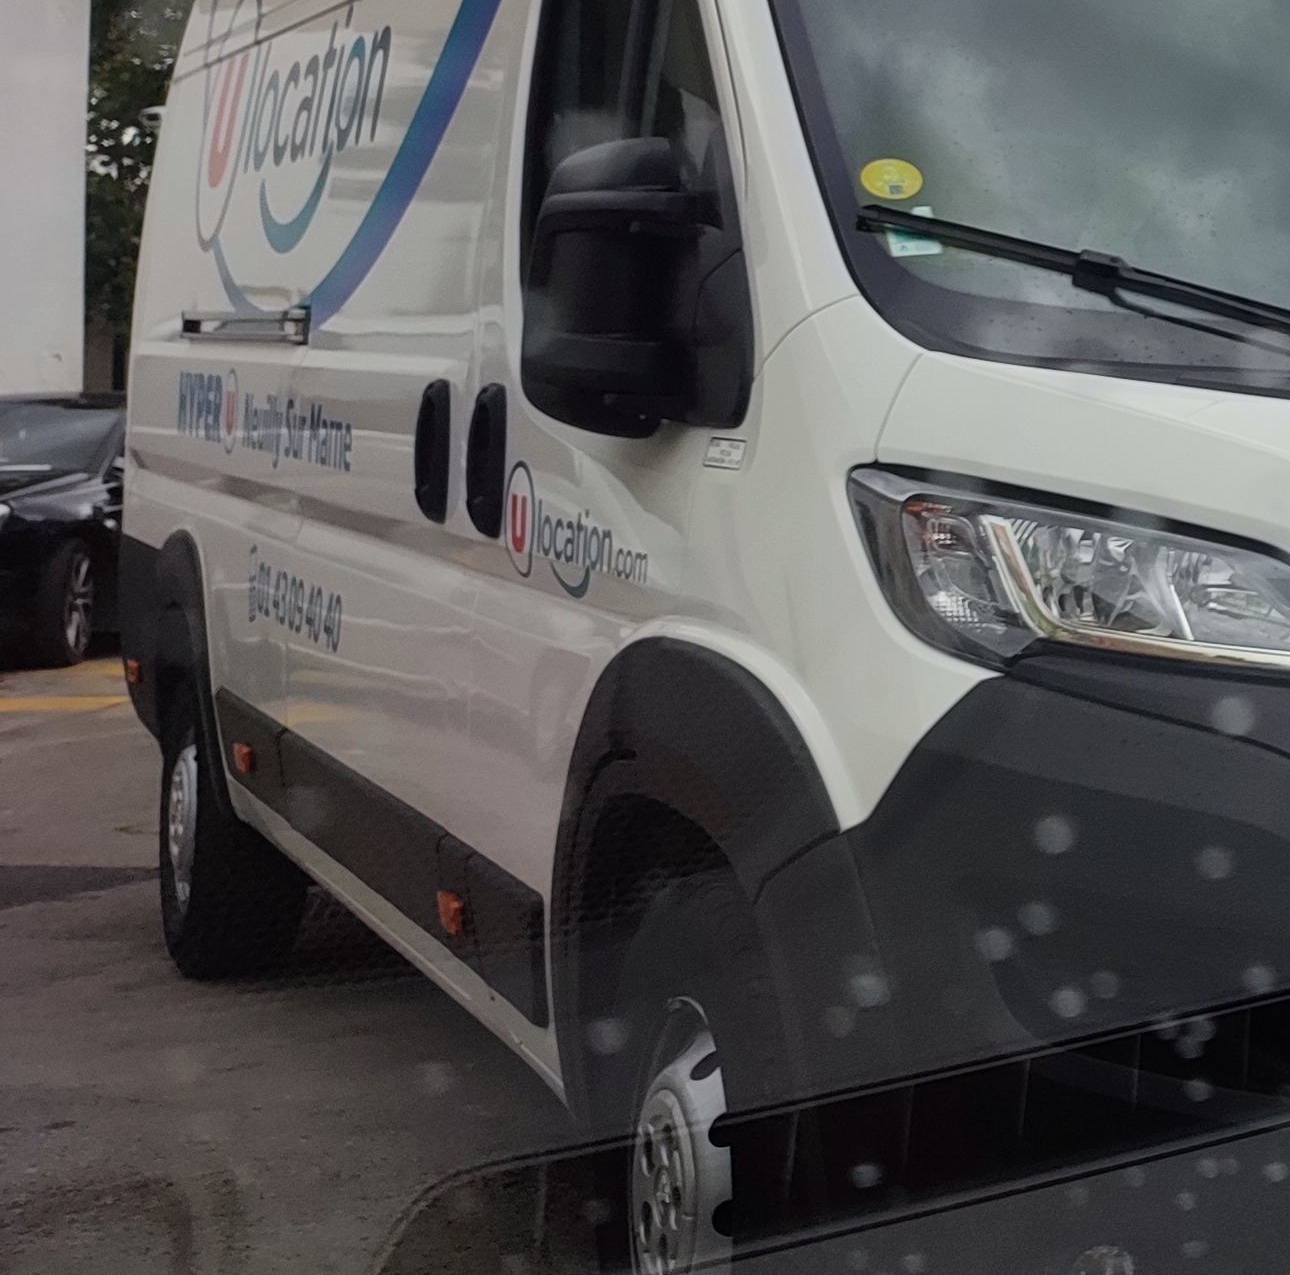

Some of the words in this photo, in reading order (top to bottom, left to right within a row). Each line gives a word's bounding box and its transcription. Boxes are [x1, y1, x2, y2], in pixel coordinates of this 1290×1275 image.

[207, 52, 250, 190] U
[243, 4, 392, 174] location
[177, 371, 223, 444] HYPER
[307, 402, 352, 472] Marne
[511, 492, 528, 553] U
